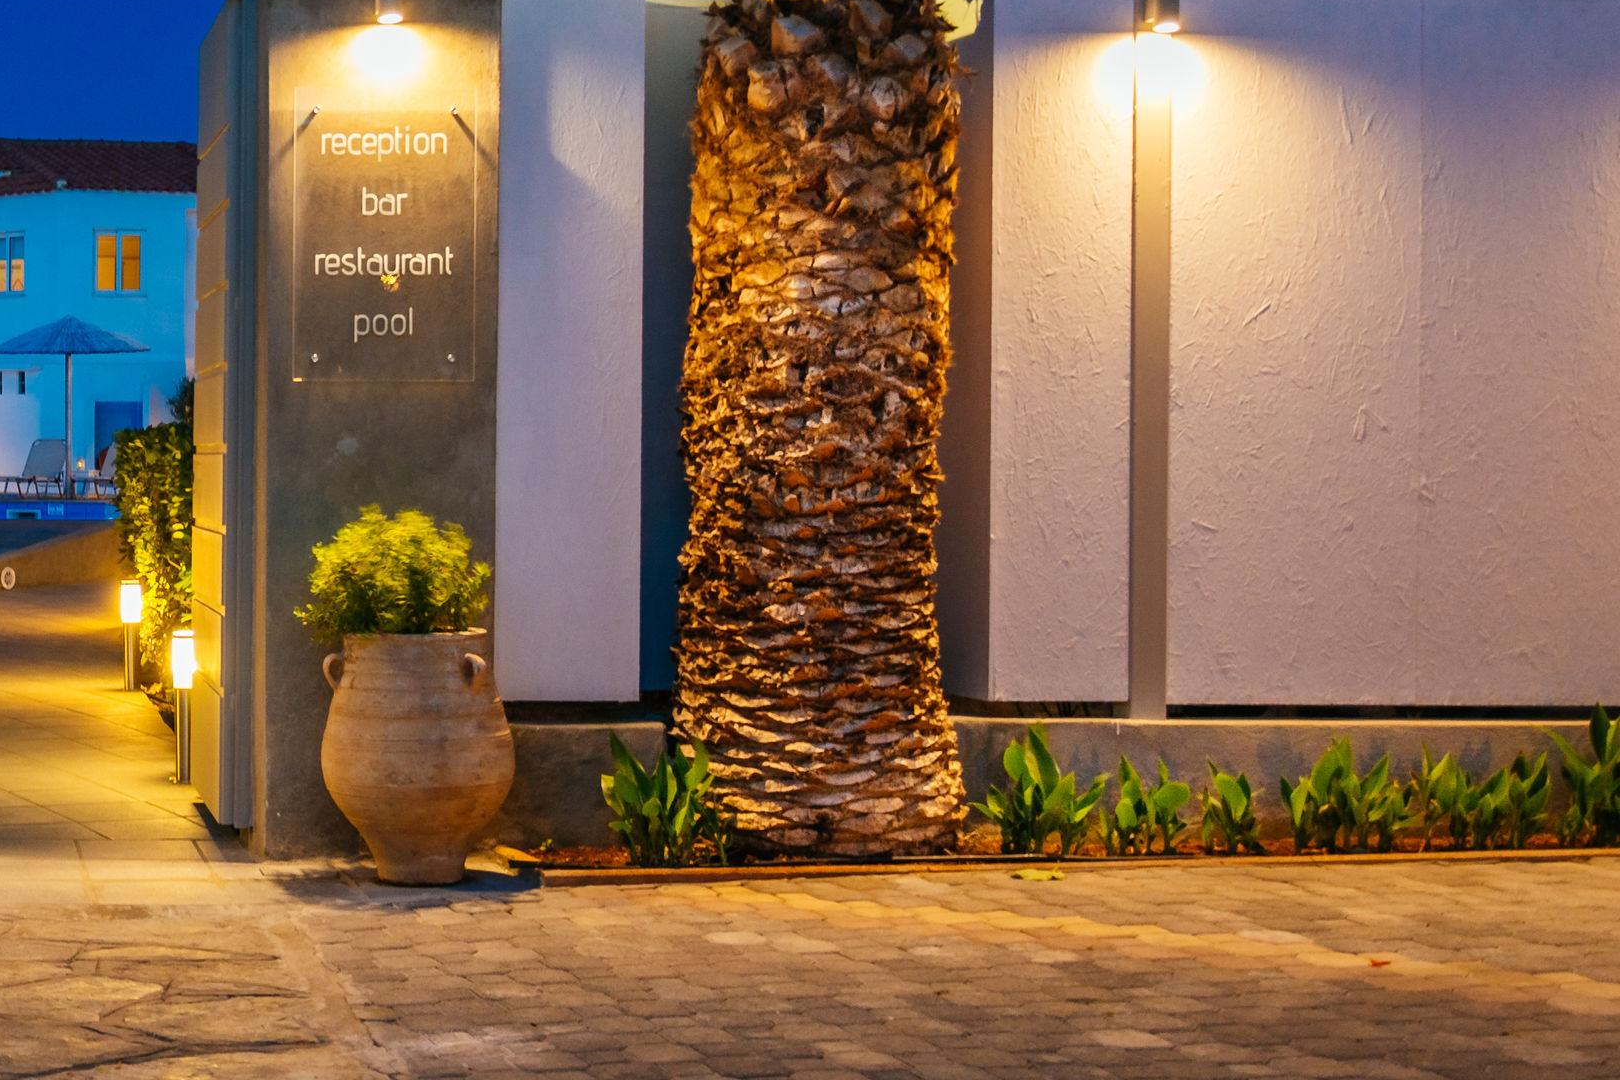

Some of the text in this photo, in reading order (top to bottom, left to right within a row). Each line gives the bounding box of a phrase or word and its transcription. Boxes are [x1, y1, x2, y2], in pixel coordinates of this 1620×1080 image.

[320, 125, 448, 162] reception
[361, 186, 409, 216] bar
[314, 246, 454, 276] restaurant
[353, 306, 413, 343] pool
